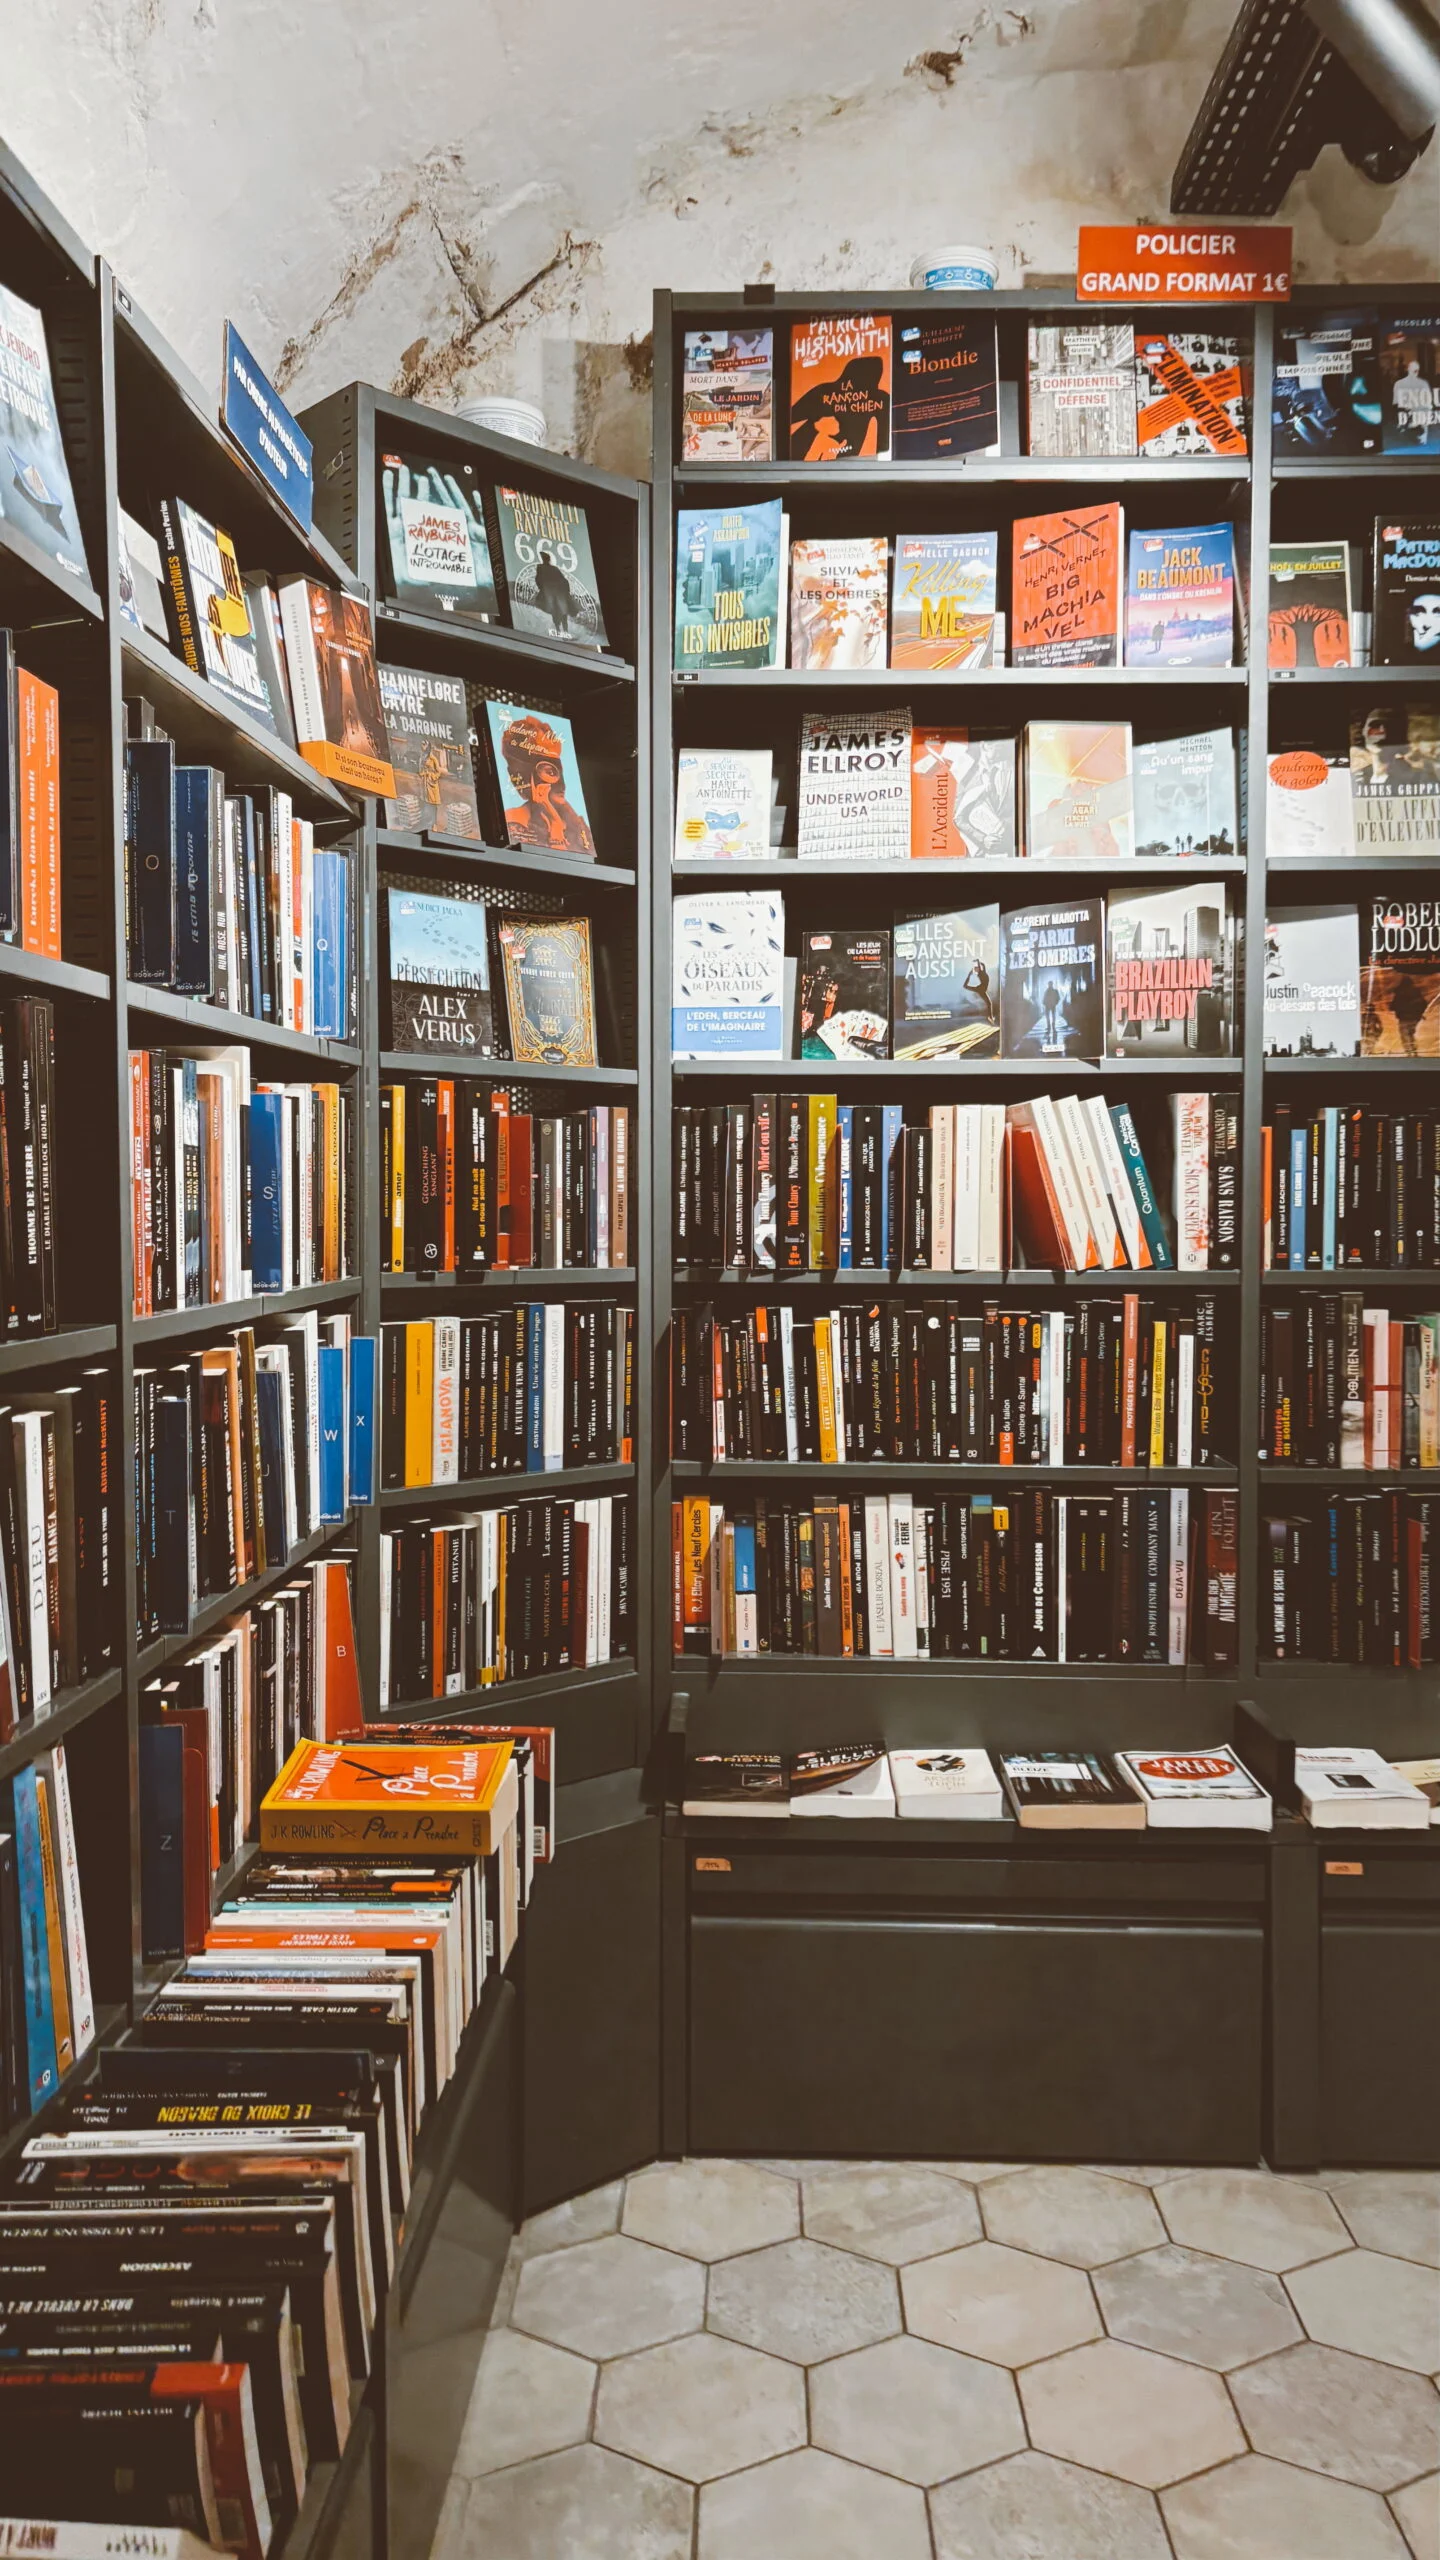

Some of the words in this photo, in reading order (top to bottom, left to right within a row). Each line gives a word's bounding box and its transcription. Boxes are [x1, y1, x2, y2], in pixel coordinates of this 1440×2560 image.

[1136, 234, 1236, 256] POLICIER
[1082, 272, 1161, 293] GRAND
[1166, 272, 1257, 292] FORMAT
[1262, 272, 1289, 293] 1€
[809, 314, 875, 337] PATRICIA
[909, 351, 979, 375] Blondie
[689, 375, 714, 384] MORT
[714, 375, 739, 384] DANS
[841, 380, 854, 392] LA
[1043, 376, 1122, 389] CONFIDENTIEL
[823, 391, 869, 406] RANÇON
[834, 402, 847, 413] DU
[850, 400, 884, 413] CHIEN
[234, 356, 247, 389] PAR
[247, 381, 268, 419] ORDRE
[268, 408, 309, 478] ALPHABÉTIQUE
[259, 427, 288, 480] D'AUTEUR
[408, 523, 467, 546] RAYBURN
[418, 515, 461, 532] JAMES
[514, 509, 573, 544] RAVENNE
[413, 544, 467, 562] L'OTAGE
[514, 532, 579, 573] 669
[1161, 547, 1203, 569] JACK
[410, 558, 473, 575] INTROUVABLE
[820, 566, 861, 576] SILVIA
[1024, 563, 1058, 588] HENRI
[1061, 547, 1107, 571] VERNET
[1137, 563, 1226, 590] BEAUMONT
[167, 555, 188, 612] FANTÔMES
[833, 578, 848, 588] ET
[901, 559, 989, 600] Killing
[1046, 574, 1080, 600] BIG
[800, 589, 822, 600] LES
[824, 588, 881, 600] OMBRES
[714, 591, 744, 621] TOUS
[919, 596, 967, 639] ME
[1023, 588, 1106, 633] MACHIA
[178, 613, 192, 631] NOS
[1044, 614, 1085, 640] VEL
[683, 626, 704, 654] LES
[708, 617, 770, 652] INVISIBLES
[378, 669, 462, 705] HANNELORE
[383, 712, 398, 731] LA
[400, 715, 454, 741] DARONNE
[809, 729, 905, 753] JAMES
[807, 751, 903, 775] ELLROY
[1151, 755, 1185, 768] Qu'un
[1188, 752, 1215, 765] sang
[1181, 764, 1215, 776] impur
[806, 787, 903, 806] UNDERWORLD
[841, 806, 868, 818] USA
[931, 772, 950, 852] L'Accident
[1050, 910, 1090, 924] MAROTTA
[905, 922, 953, 942] ELLES
[1028, 927, 1076, 948] PARMI
[905, 939, 987, 960] DANSENT
[1009, 951, 1036, 970] LES
[1037, 944, 1096, 968] OMBRES
[905, 960, 955, 979] AUSSI
[1115, 958, 1213, 990] BRAZILIAN
[1265, 984, 1299, 998] Justin
[418, 995, 468, 1020] ALEX
[1115, 989, 1199, 1021] PLAYBOY
[412, 1018, 477, 1045] VERUS
[686, 1022, 699, 1032] DE
[701, 1022, 767, 1031] L'IMAGINAIRE
[757, 1115, 771, 1132] vif
[1118, 1114, 1131, 1145] Patricia
[1214, 1108, 1226, 1157] CORNWELL
[1227, 1116, 1237, 1150] PATRICIA
[760, 1132, 771, 1145] ou
[1127, 1114, 1141, 1157] Cornwell
[757, 1146, 771, 1171] Mort
[815, 1116, 828, 1184] Cybermenace
[25, 1144, 35, 1188] PIERRE
[430, 1152, 438, 1197] SANGLANT
[758, 1172, 773, 1202] Clancy
[1133, 1166, 1153, 1215] Quantum
[1218, 1165, 1235, 1196] SANS
[26, 1190, 36, 1207] DE
[787, 1184, 802, 1209] Clancy
[758, 1202, 770, 1222] Tom
[787, 1209, 799, 1227] Tom
[1218, 1199, 1235, 1243] RAISON
[26, 1210, 38, 1265] L'HOMME
[479, 1224, 487, 1238] qui
[516, 1309, 524, 1330] CARR
[1196, 1307, 1206, 1335] MARC
[1205, 1302, 1215, 1342] ELSBERG
[516, 1330, 524, 1356] CALEB
[891, 1316, 901, 1357] Delplanque
[515, 1361, 523, 1386] TEMPS
[1126, 1357, 1135, 1379] DIEUX
[1347, 1348, 1359, 1400] DOLMEN
[515, 1387, 523, 1398] DE
[1018, 1376, 1026, 1400] Santal
[1126, 1379, 1135, 1393] DES
[439, 1376, 454, 1454] ISLANOVA
[515, 1398, 523, 1424] TUEUR
[1003, 1399, 1011, 1420] talion
[1018, 1400, 1026, 1410] du
[355, 1415, 365, 1427] X
[515, 1423, 523, 1435] LE
[1003, 1420, 1011, 1431] du
[1018, 1411, 1026, 1444] L'ombre
[323, 1429, 339, 1442] W
[1003, 1432, 1011, 1442] loi
[1003, 1442, 1011, 1453] La
[543, 1506, 551, 1542] cassure
[690, 1508, 702, 1538] Cercles
[1148, 1510, 1158, 1531] MAN
[1210, 1511, 1223, 1537] KEN
[1221, 1497, 1236, 1550] FOLLETT
[542, 1544, 551, 1557] La
[690, 1539, 702, 1557] Neuf
[1147, 1533, 1158, 1577] COMPANY
[32, 1524, 45, 1618] DIEU
[690, 1559, 702, 1573] Les
[941, 1550, 951, 1576] PISE
[691, 1574, 704, 1597] Ellory
[941, 1576, 951, 1599] 1951
[1034, 1596, 1044, 1606] DE
[1033, 1607, 1044, 1632] JOUR
[1220, 1608, 1235, 1622] AU
[336, 1645, 346, 1658] B
[429, 1750, 480, 1793] Prendre
[1150, 1758, 1216, 1769] JAMES
[1162, 1764, 1235, 1775] ELLROY
[380, 1765, 430, 1796] Place
[157, 2105, 220, 2122] DRAGON
[221, 2105, 243, 2121] DU
[246, 2104, 291, 2120] CHOIX
[293, 2104, 312, 2120] LE
[119, 2262, 192, 2272] ASCENSION
